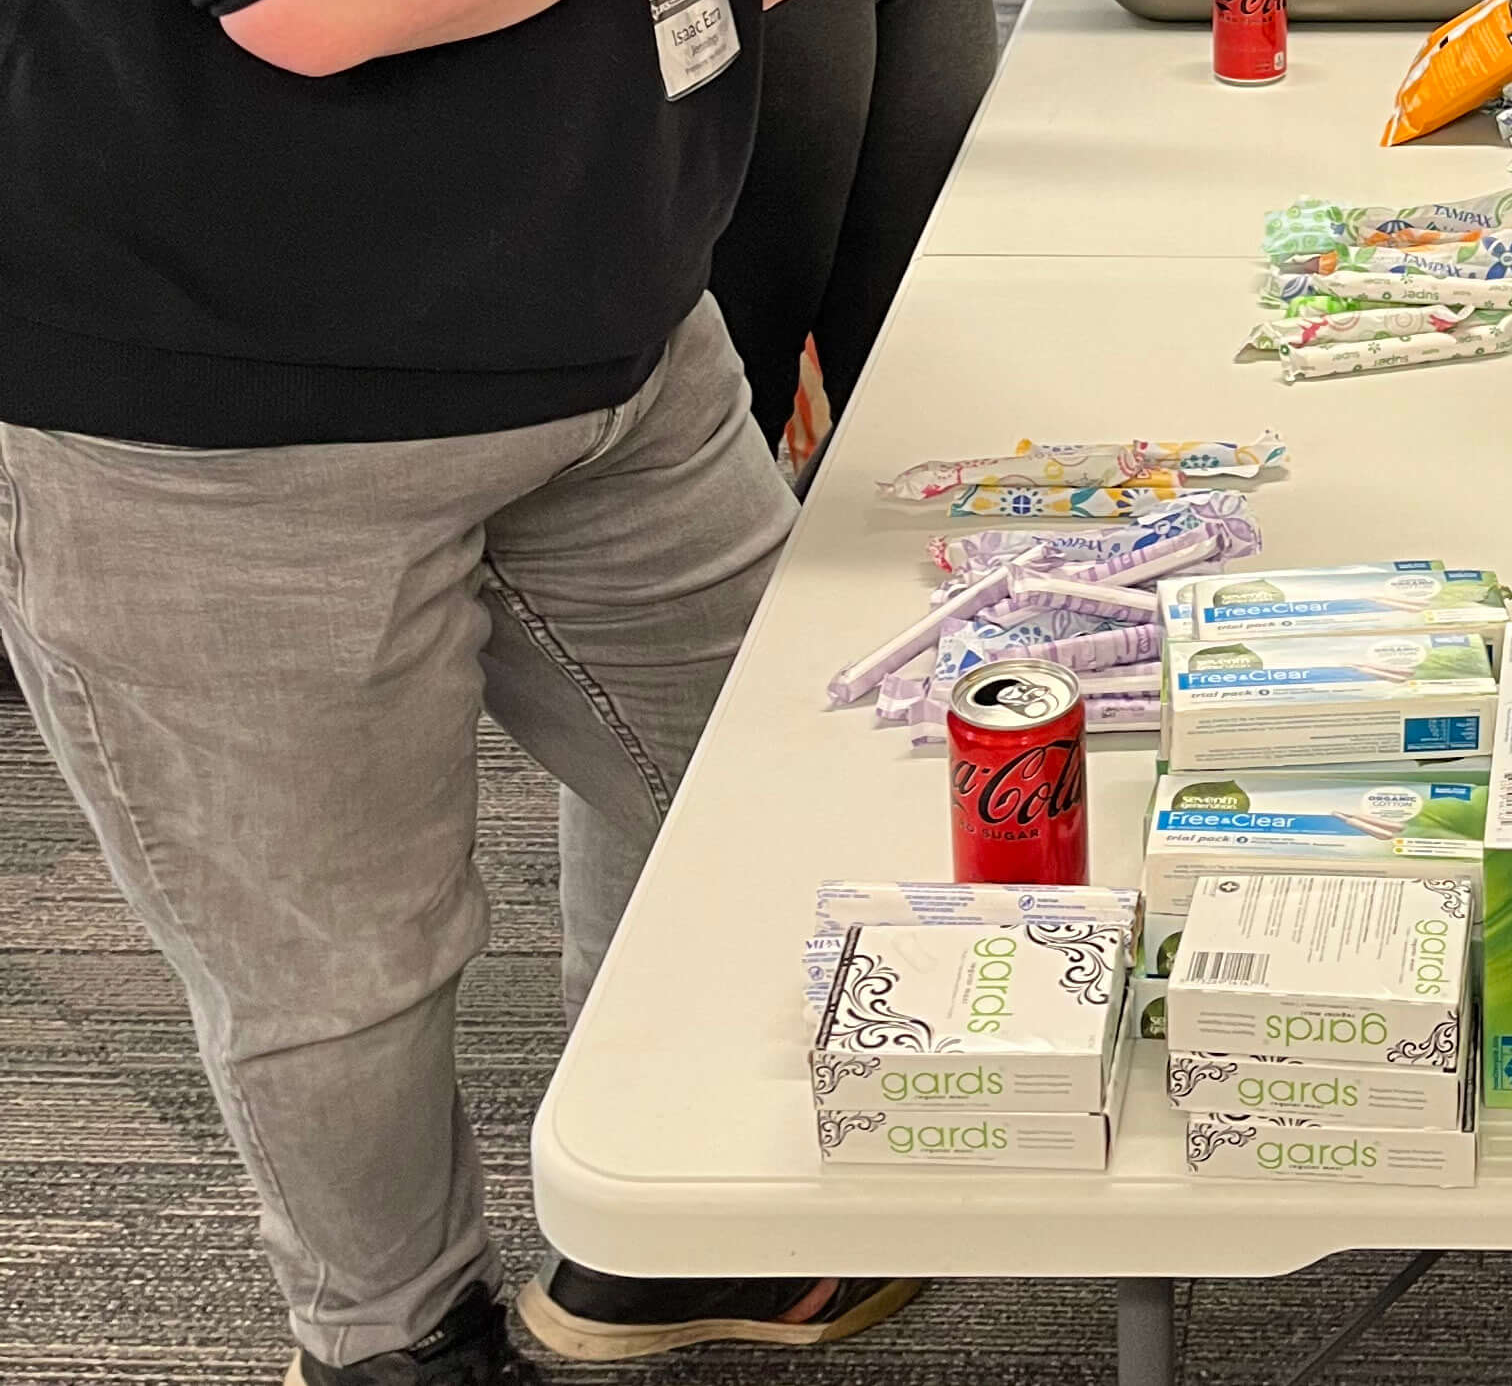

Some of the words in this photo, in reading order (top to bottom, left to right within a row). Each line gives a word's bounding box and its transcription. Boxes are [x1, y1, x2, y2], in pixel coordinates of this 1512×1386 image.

[671, 20, 702, 47] Isaac
[1431, 203, 1493, 229] TAMPAX
[1181, 794, 1239, 806] seventh
[982, 828, 1039, 841] SUGAR
[1166, 833, 1194, 843] trial
[1196, 833, 1231, 844] pack
[1415, 918, 1450, 996] gards
[967, 936, 1017, 1034] gards
[1265, 1011, 1388, 1047] gards
[881, 1064, 1004, 1102] gards
[1236, 1077, 1359, 1107] gards
[887, 1121, 1008, 1154] gards
[1256, 1139, 1378, 1170] gards
